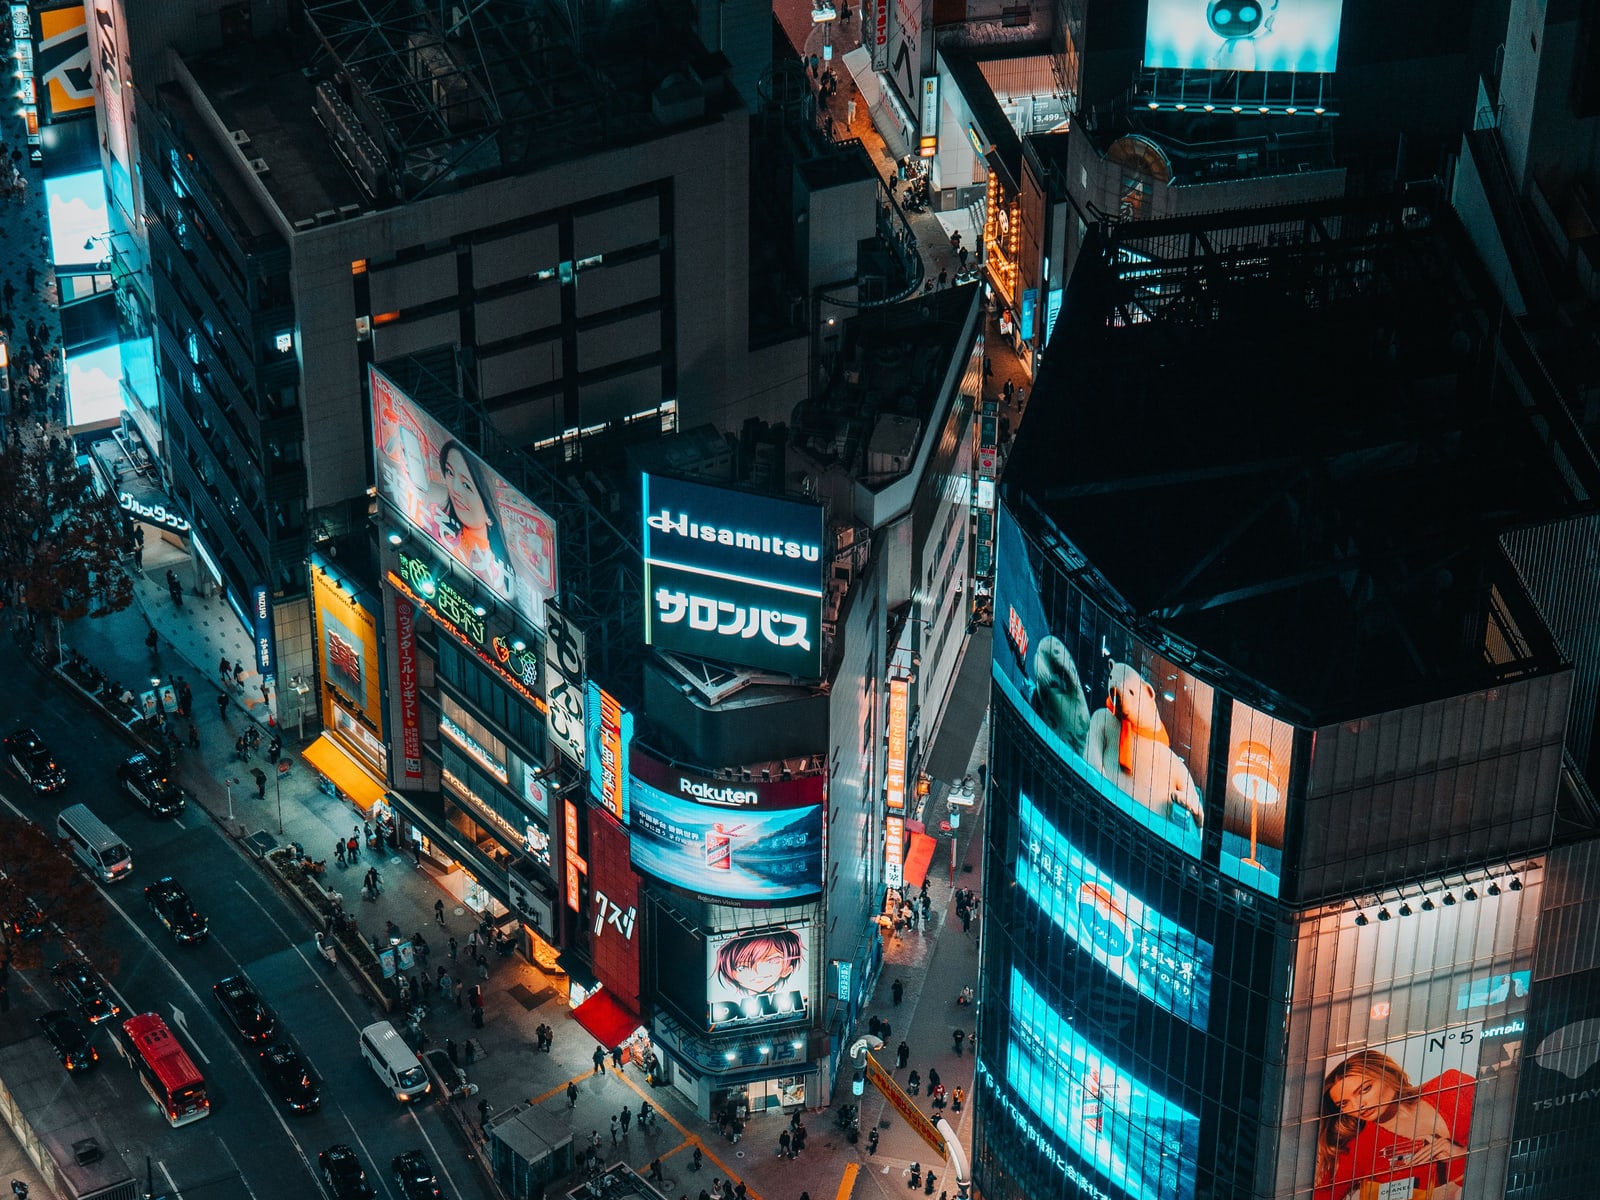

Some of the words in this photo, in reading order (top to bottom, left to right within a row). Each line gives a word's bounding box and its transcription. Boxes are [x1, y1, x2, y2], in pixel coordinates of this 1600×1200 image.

[647, 510, 819, 561] Hisamitsu
[257, 591, 267, 619] MIZUHO
[655, 588, 811, 652] サロンパス
[600, 703, 619, 815] 三千里薬品
[679, 777, 758, 805] Rakuten
